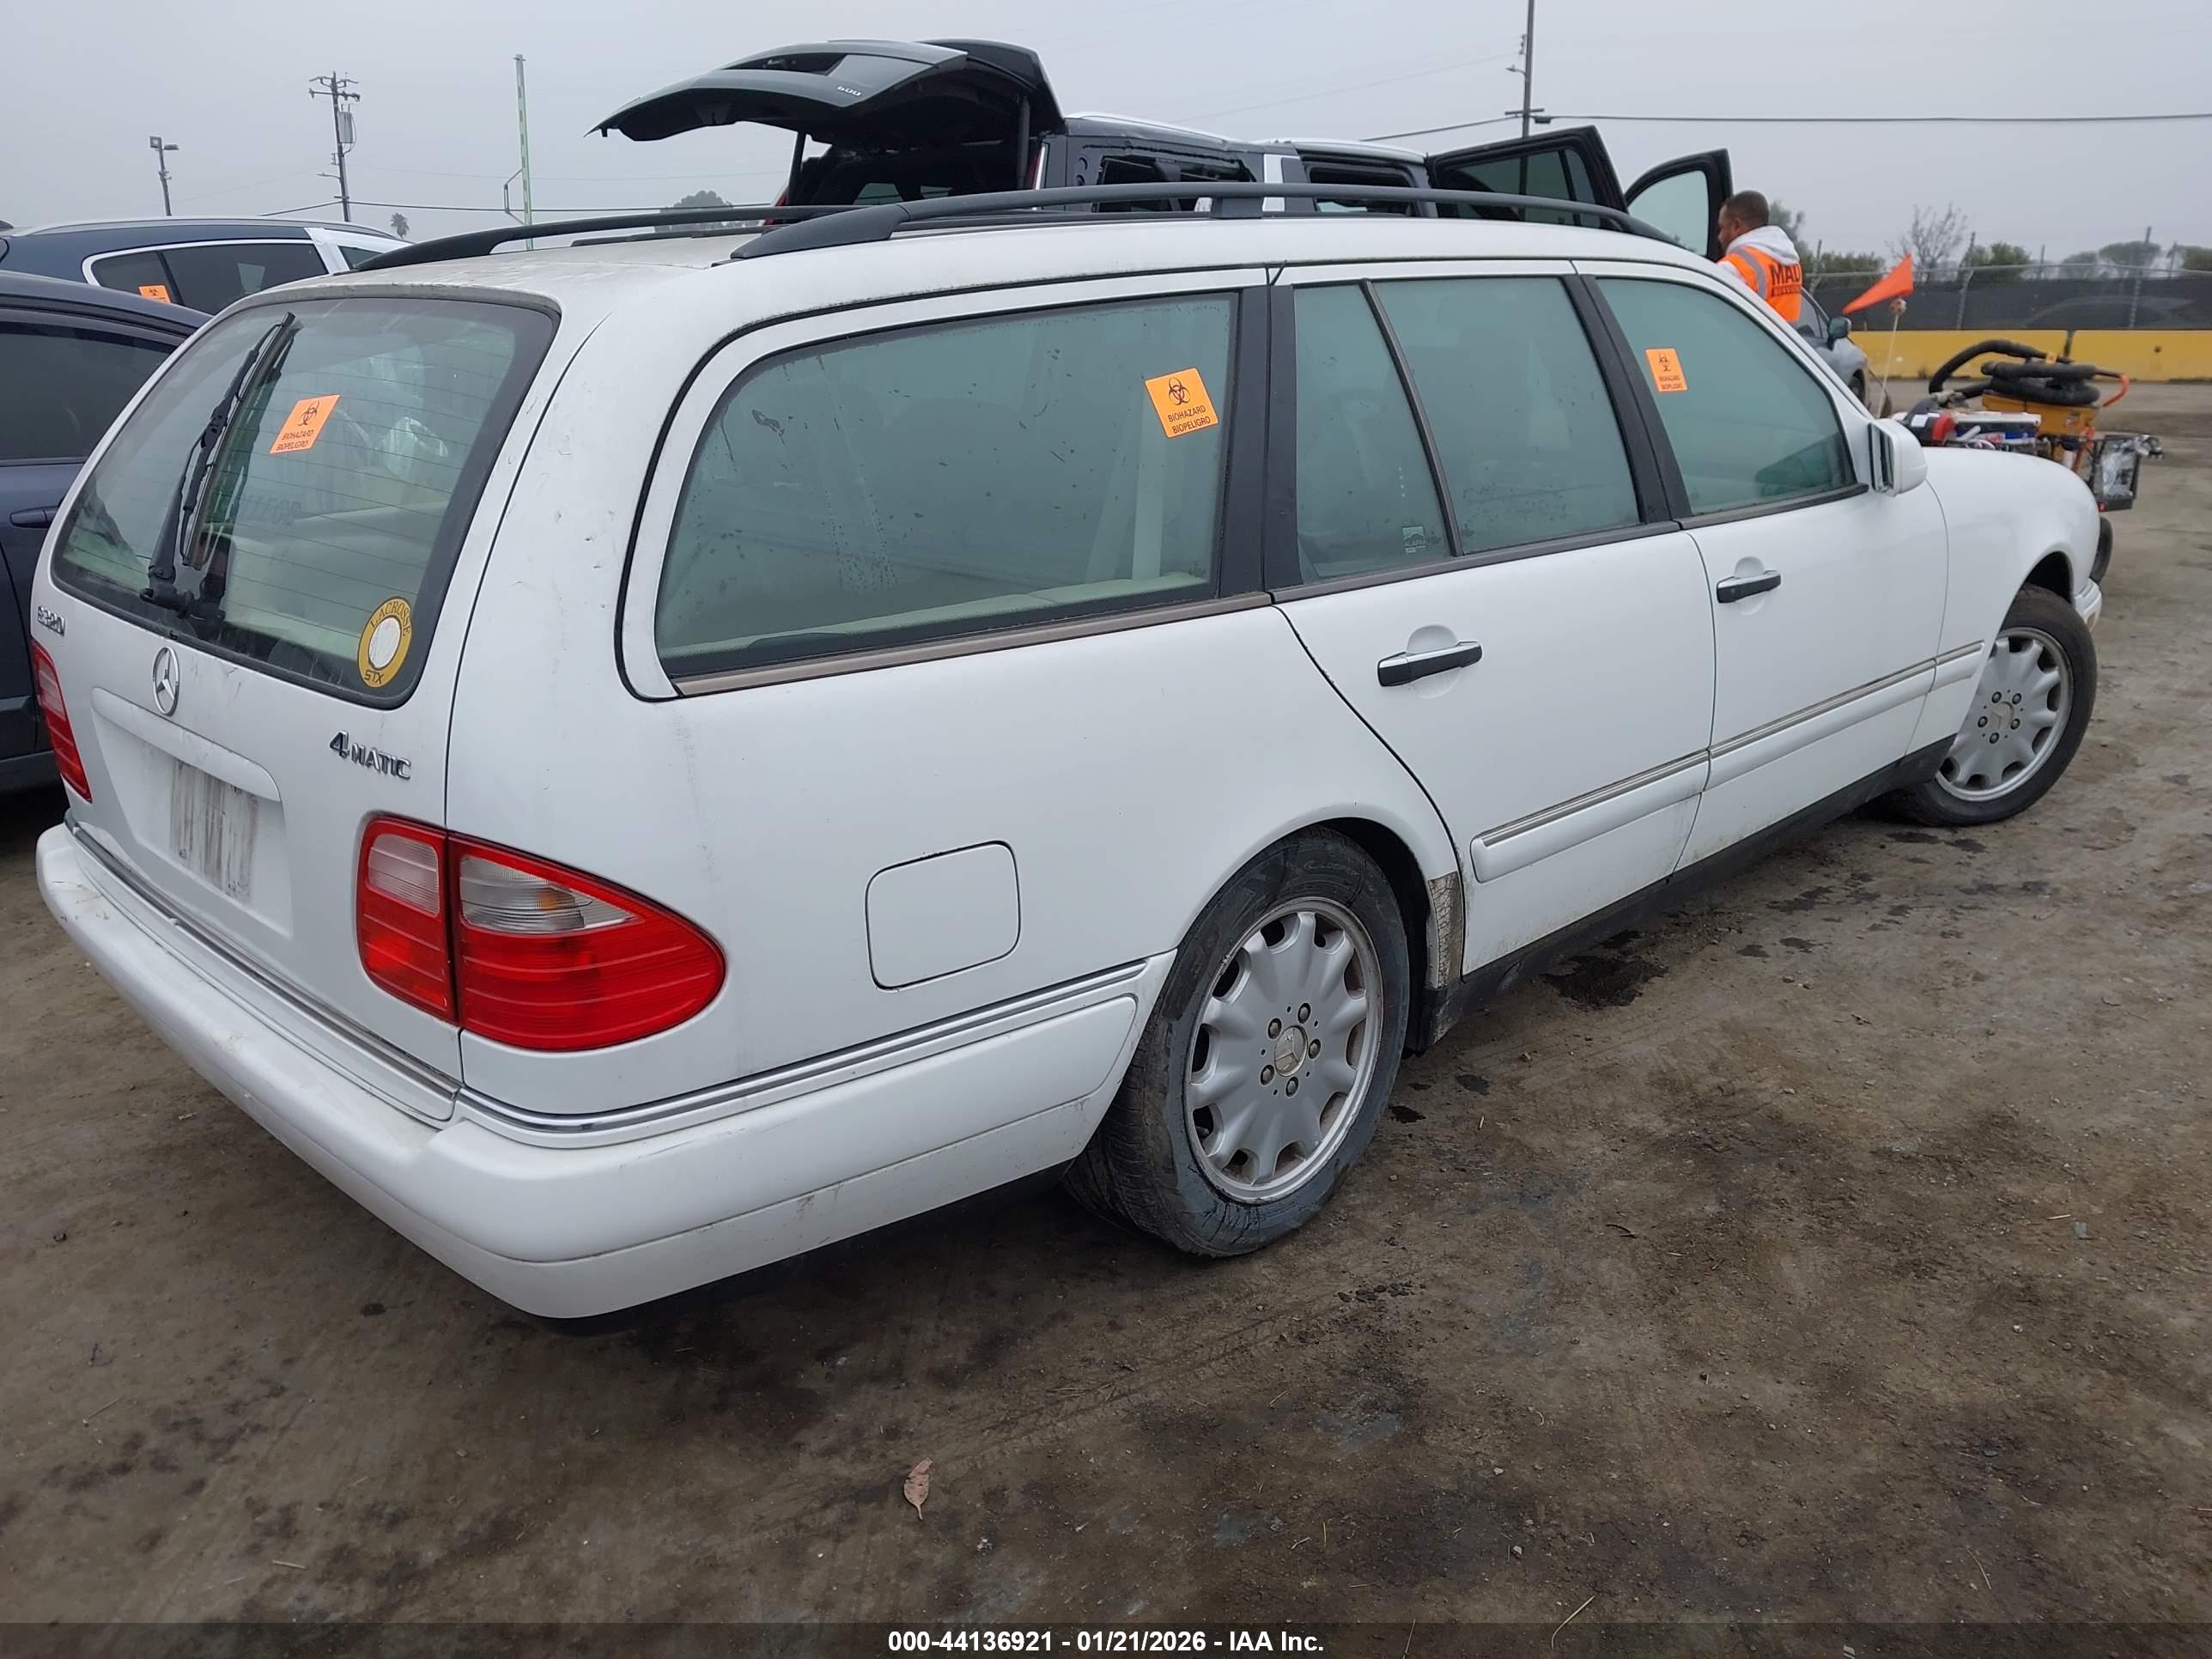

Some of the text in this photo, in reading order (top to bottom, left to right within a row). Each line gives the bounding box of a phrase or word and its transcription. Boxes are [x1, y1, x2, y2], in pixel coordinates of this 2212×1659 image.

[1167, 405, 1206, 422] BIOHAZARD
[1172, 416, 1211, 434] BIOPELIGRO
[282, 429, 314, 441] BIOHAZARD
[364, 670, 384, 684] STX
